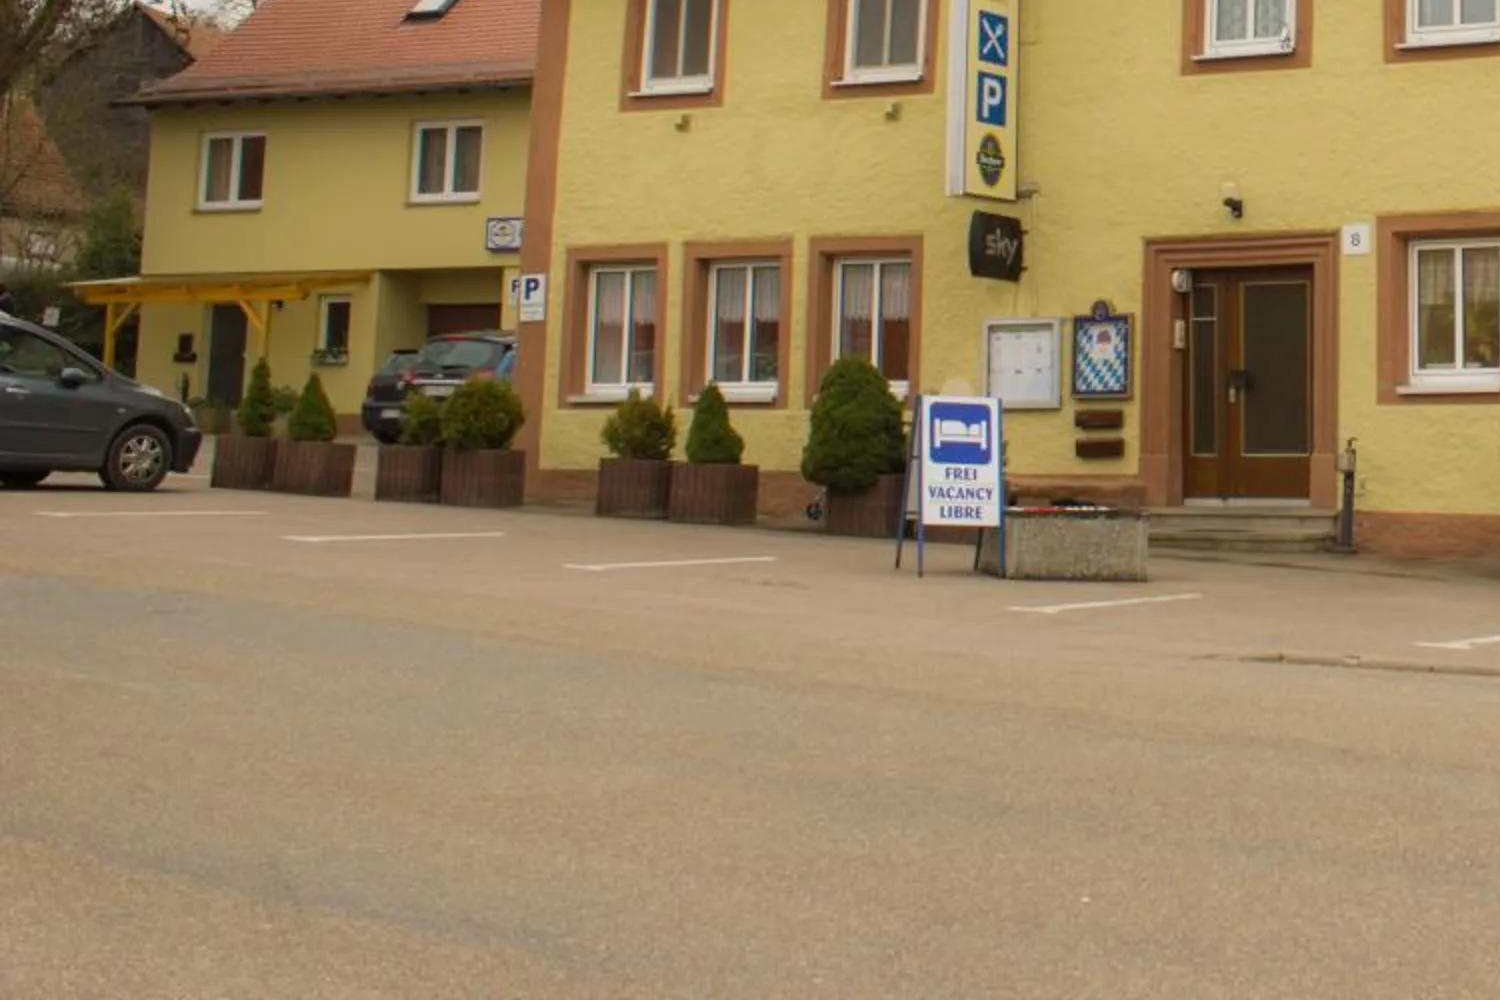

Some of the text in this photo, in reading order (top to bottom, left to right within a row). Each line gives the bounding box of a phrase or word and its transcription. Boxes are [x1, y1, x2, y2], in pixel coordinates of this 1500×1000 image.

[983, 77, 1002, 117] P
[985, 228, 1018, 265] sky
[1351, 232, 1361, 247] 8
[525, 278, 539, 300] P
[945, 467, 977, 480] FREI
[928, 486, 993, 501] VACANCY
[940, 505, 984, 519] LIBRE
